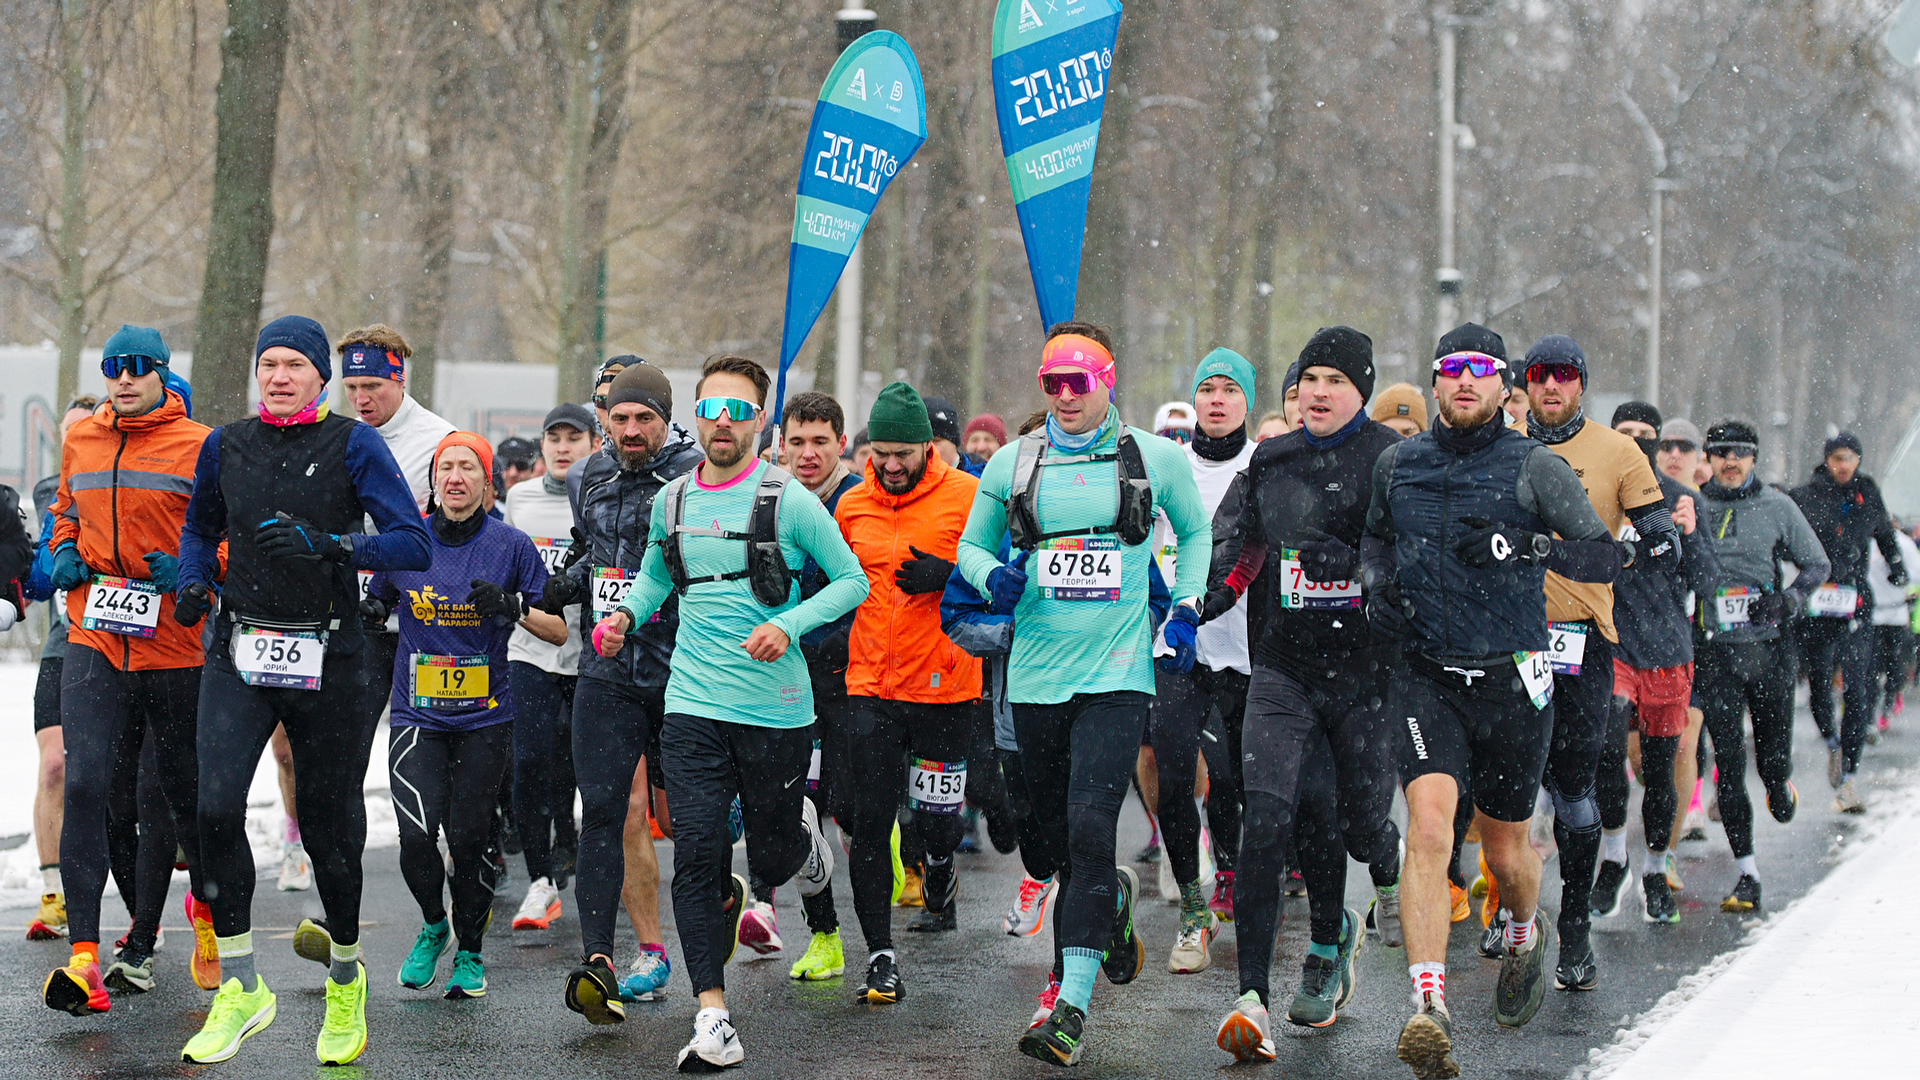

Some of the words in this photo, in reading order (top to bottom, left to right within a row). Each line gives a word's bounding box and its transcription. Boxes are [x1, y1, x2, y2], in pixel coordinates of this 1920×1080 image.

[1010, 51, 1104, 126] 20:00
[815, 130, 888, 195] 20:00
[1025, 150, 1065, 180] 4:00
[1065, 155, 1083, 170] КМ
[803, 210, 834, 238] 4:00
[831, 229, 846, 242] КМ
[1049, 553, 1111, 576] 6784
[1062, 577, 1097, 585] ГЕОРГИЙ
[94, 588, 150, 615] 2443
[437, 603, 450, 611] АК
[452, 603, 475, 611] БАРС
[102, 611, 134, 622] АЛЕКСЕЙ
[437, 619, 481, 627] МАРАФОН
[254, 637, 302, 664] 956
[263, 663, 288, 672] ЮРИЙ
[440, 669, 466, 689] 19
[1407, 717, 1429, 760] ADIXION
[915, 771, 961, 795] 4153
[926, 794, 949, 802] ВЮГАР
